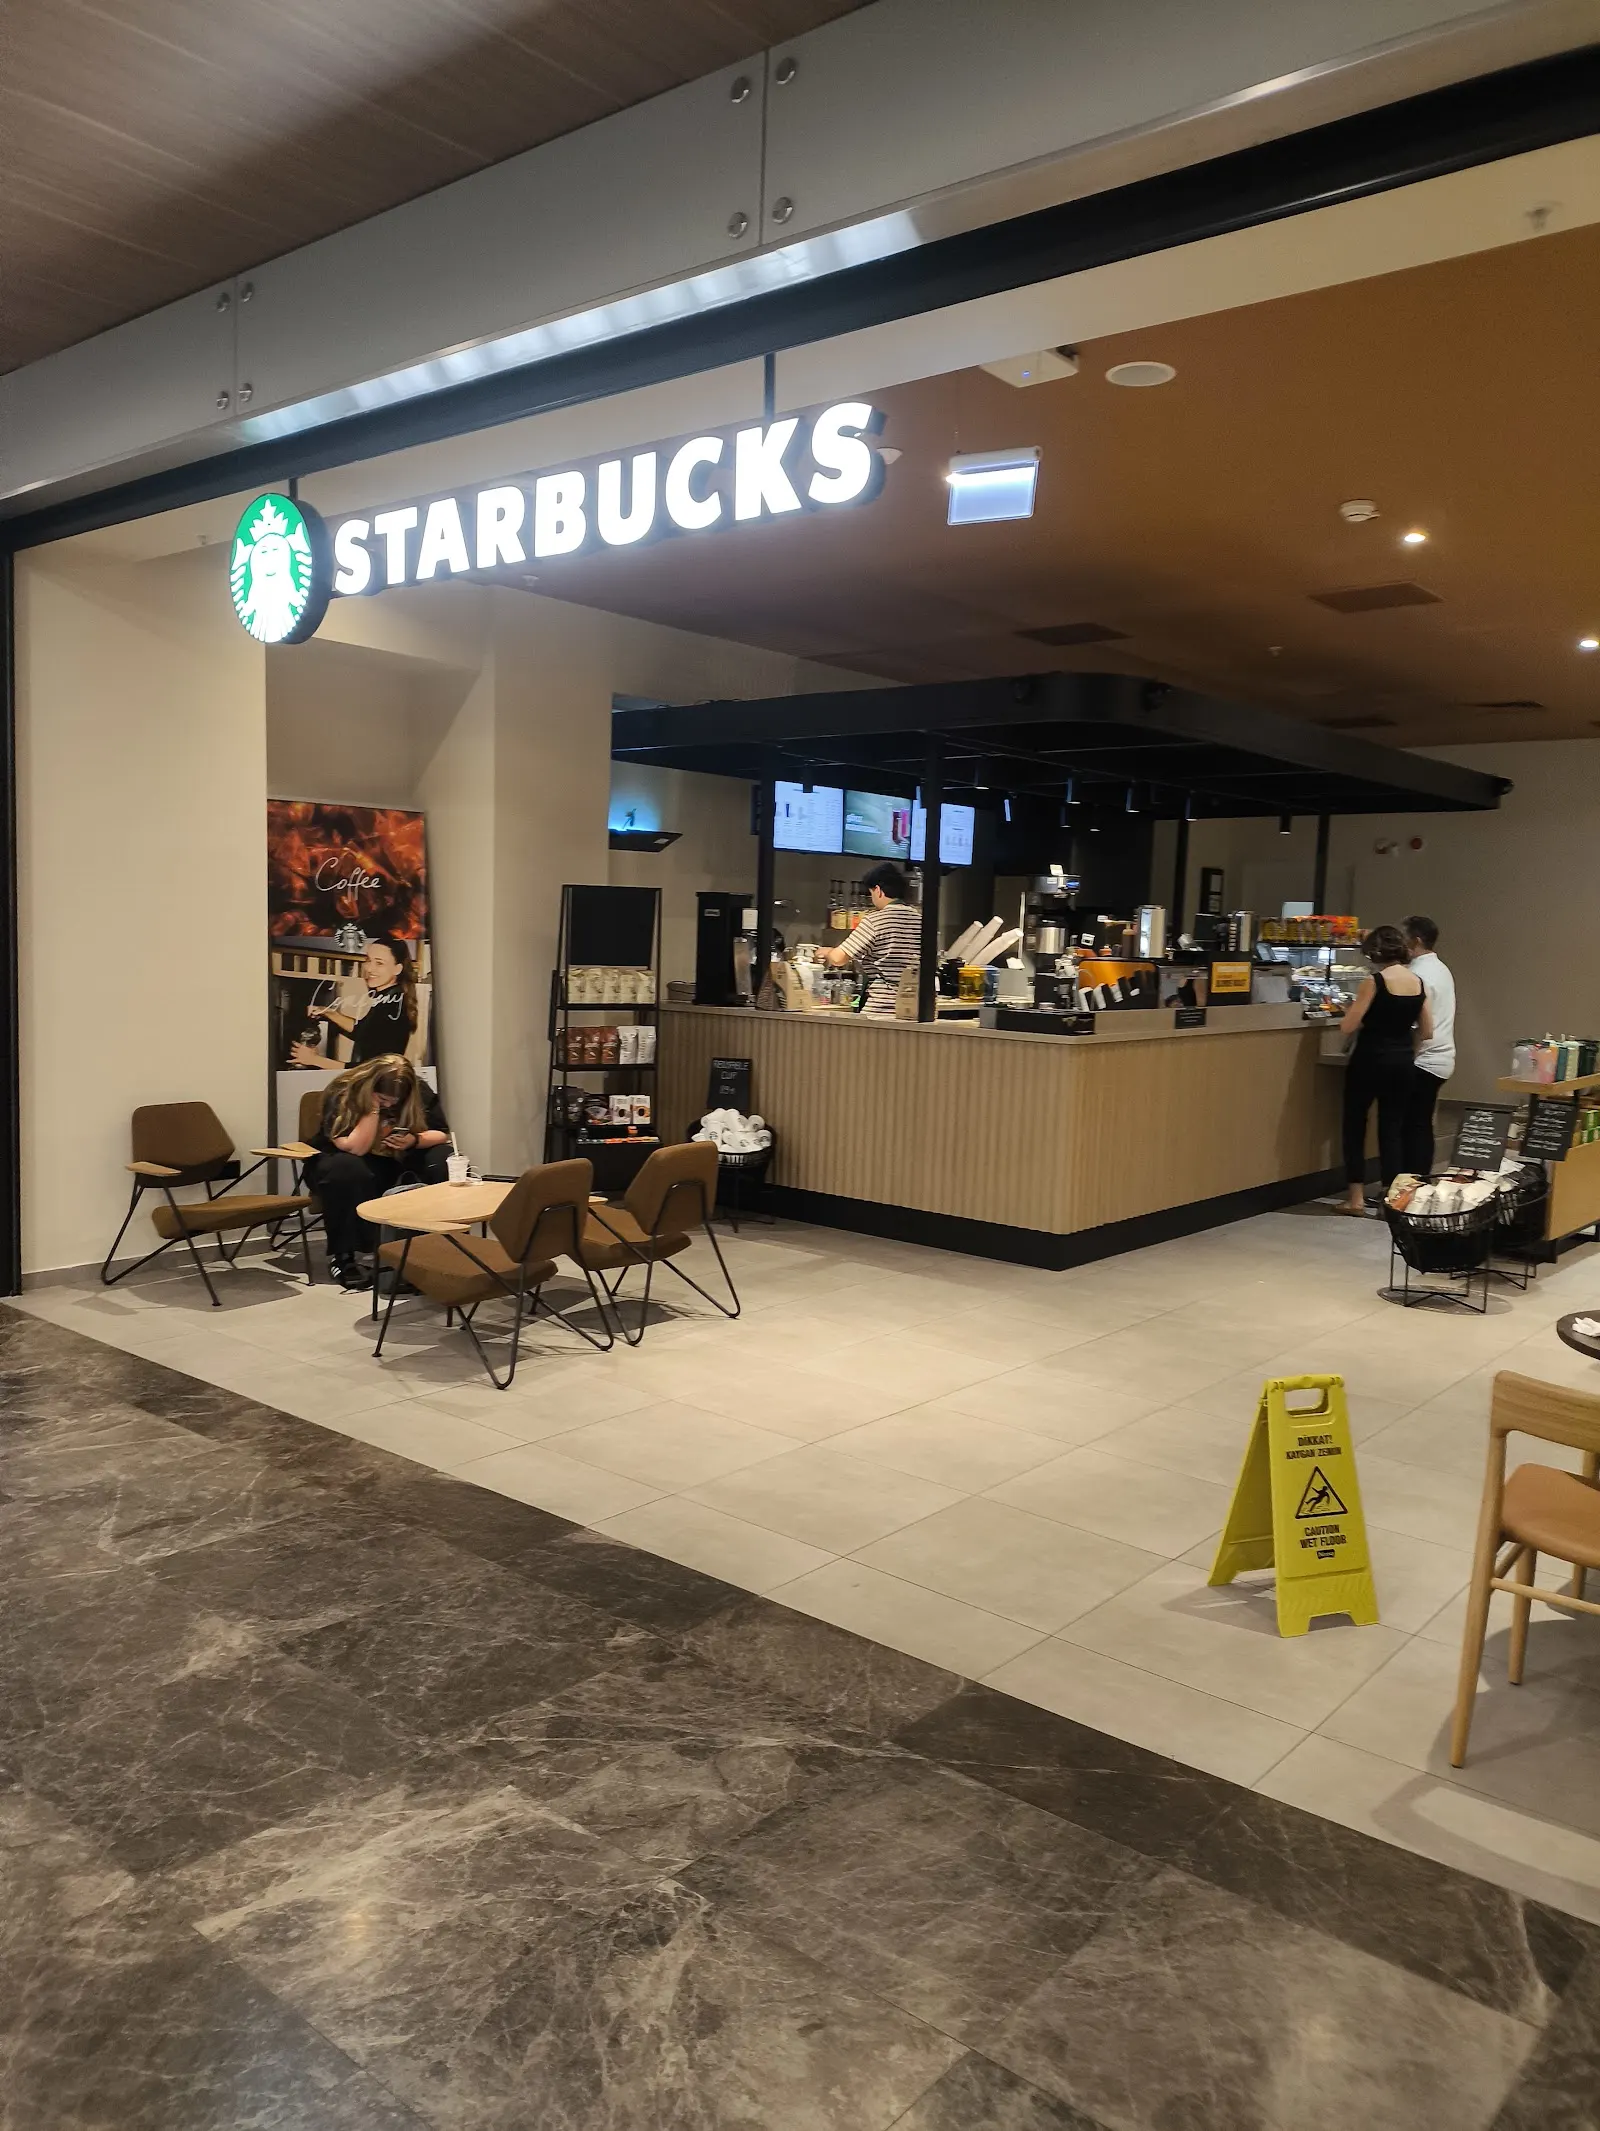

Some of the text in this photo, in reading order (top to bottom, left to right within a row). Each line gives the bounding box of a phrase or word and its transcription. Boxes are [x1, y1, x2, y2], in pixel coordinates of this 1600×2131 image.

[334, 402, 873, 595] STARBUCKS
[315, 857, 382, 901] Coffee
[309, 979, 405, 1026] Copany
[1286, 1448, 1316, 1460] KAYGAN
[1300, 1535, 1347, 1549] WET FLOOR
[1304, 1524, 1340, 1536] CAUTION
